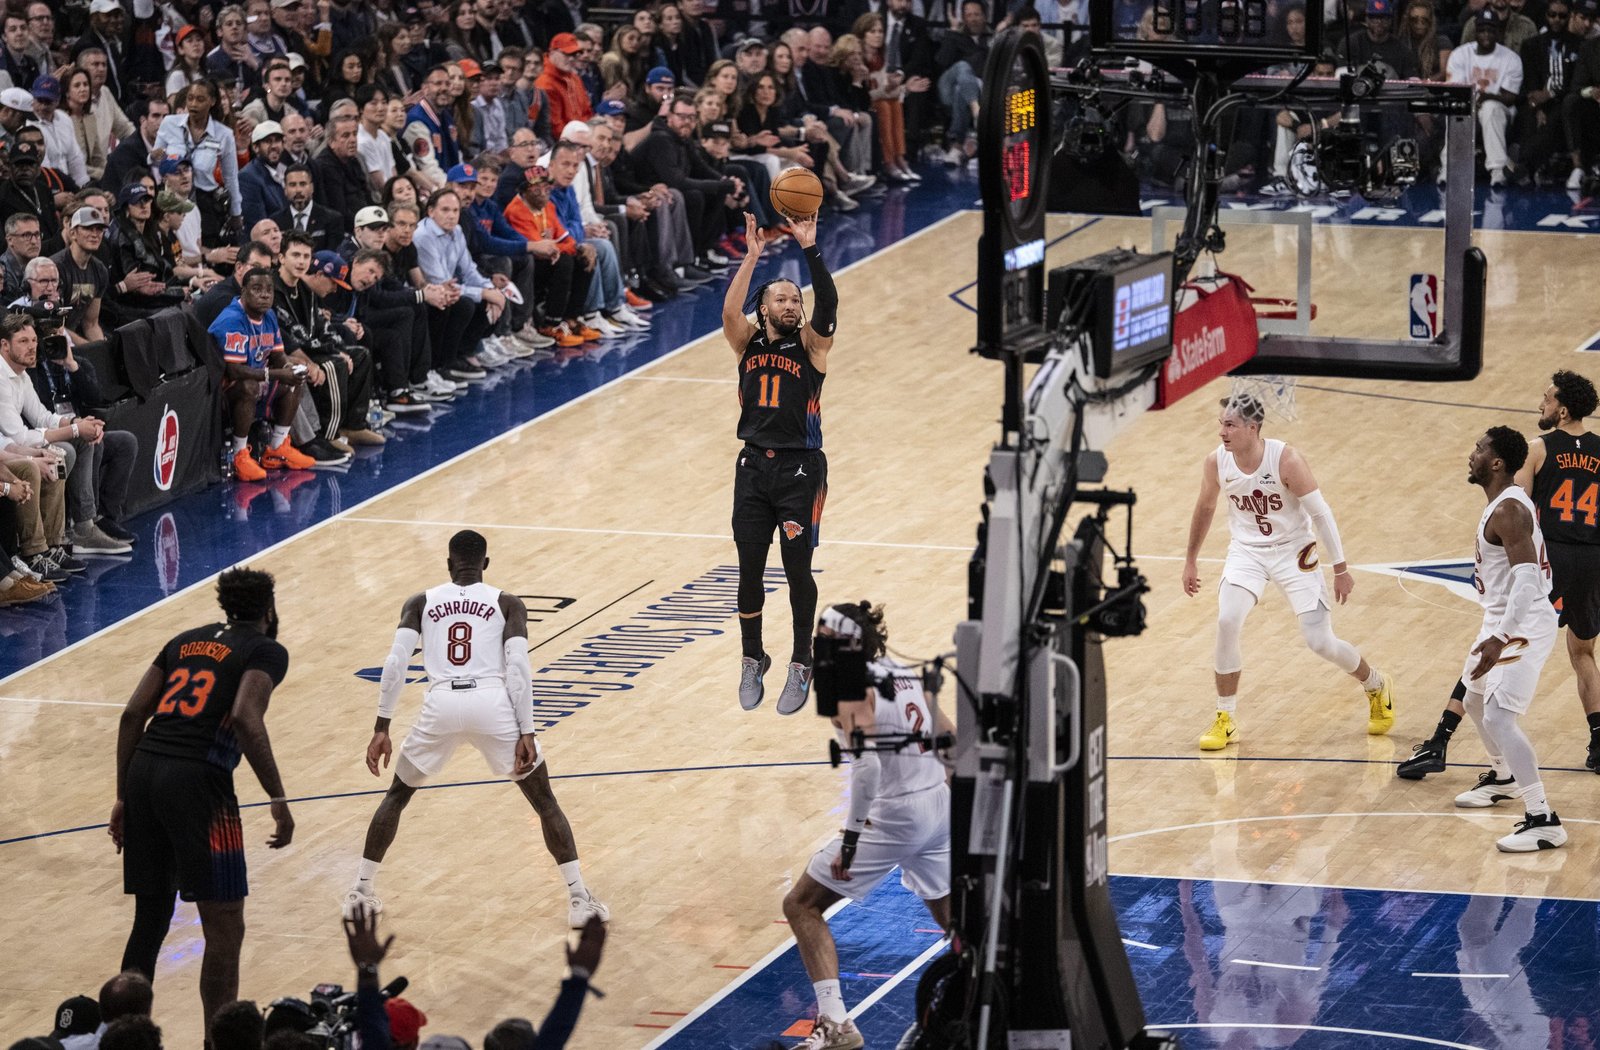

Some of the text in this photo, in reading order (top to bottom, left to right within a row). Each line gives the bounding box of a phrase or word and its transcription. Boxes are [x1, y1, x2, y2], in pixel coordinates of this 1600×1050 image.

[1412, 324, 1428, 336] NBA
[745, 353, 802, 379] NEW YORK
[758, 374, 780, 408] 11
[1229, 492, 1283, 516] CAVS
[1550, 479, 1599, 527] 44
[1255, 515, 1273, 536] 5
[428, 599, 496, 623] SCHRÖDER
[179, 641, 232, 663] ROBINSON
[447, 621, 473, 667] 8
[537, 624, 724, 677] SQUARE
[156, 668, 216, 717] 23
[905, 702, 929, 755] 2
